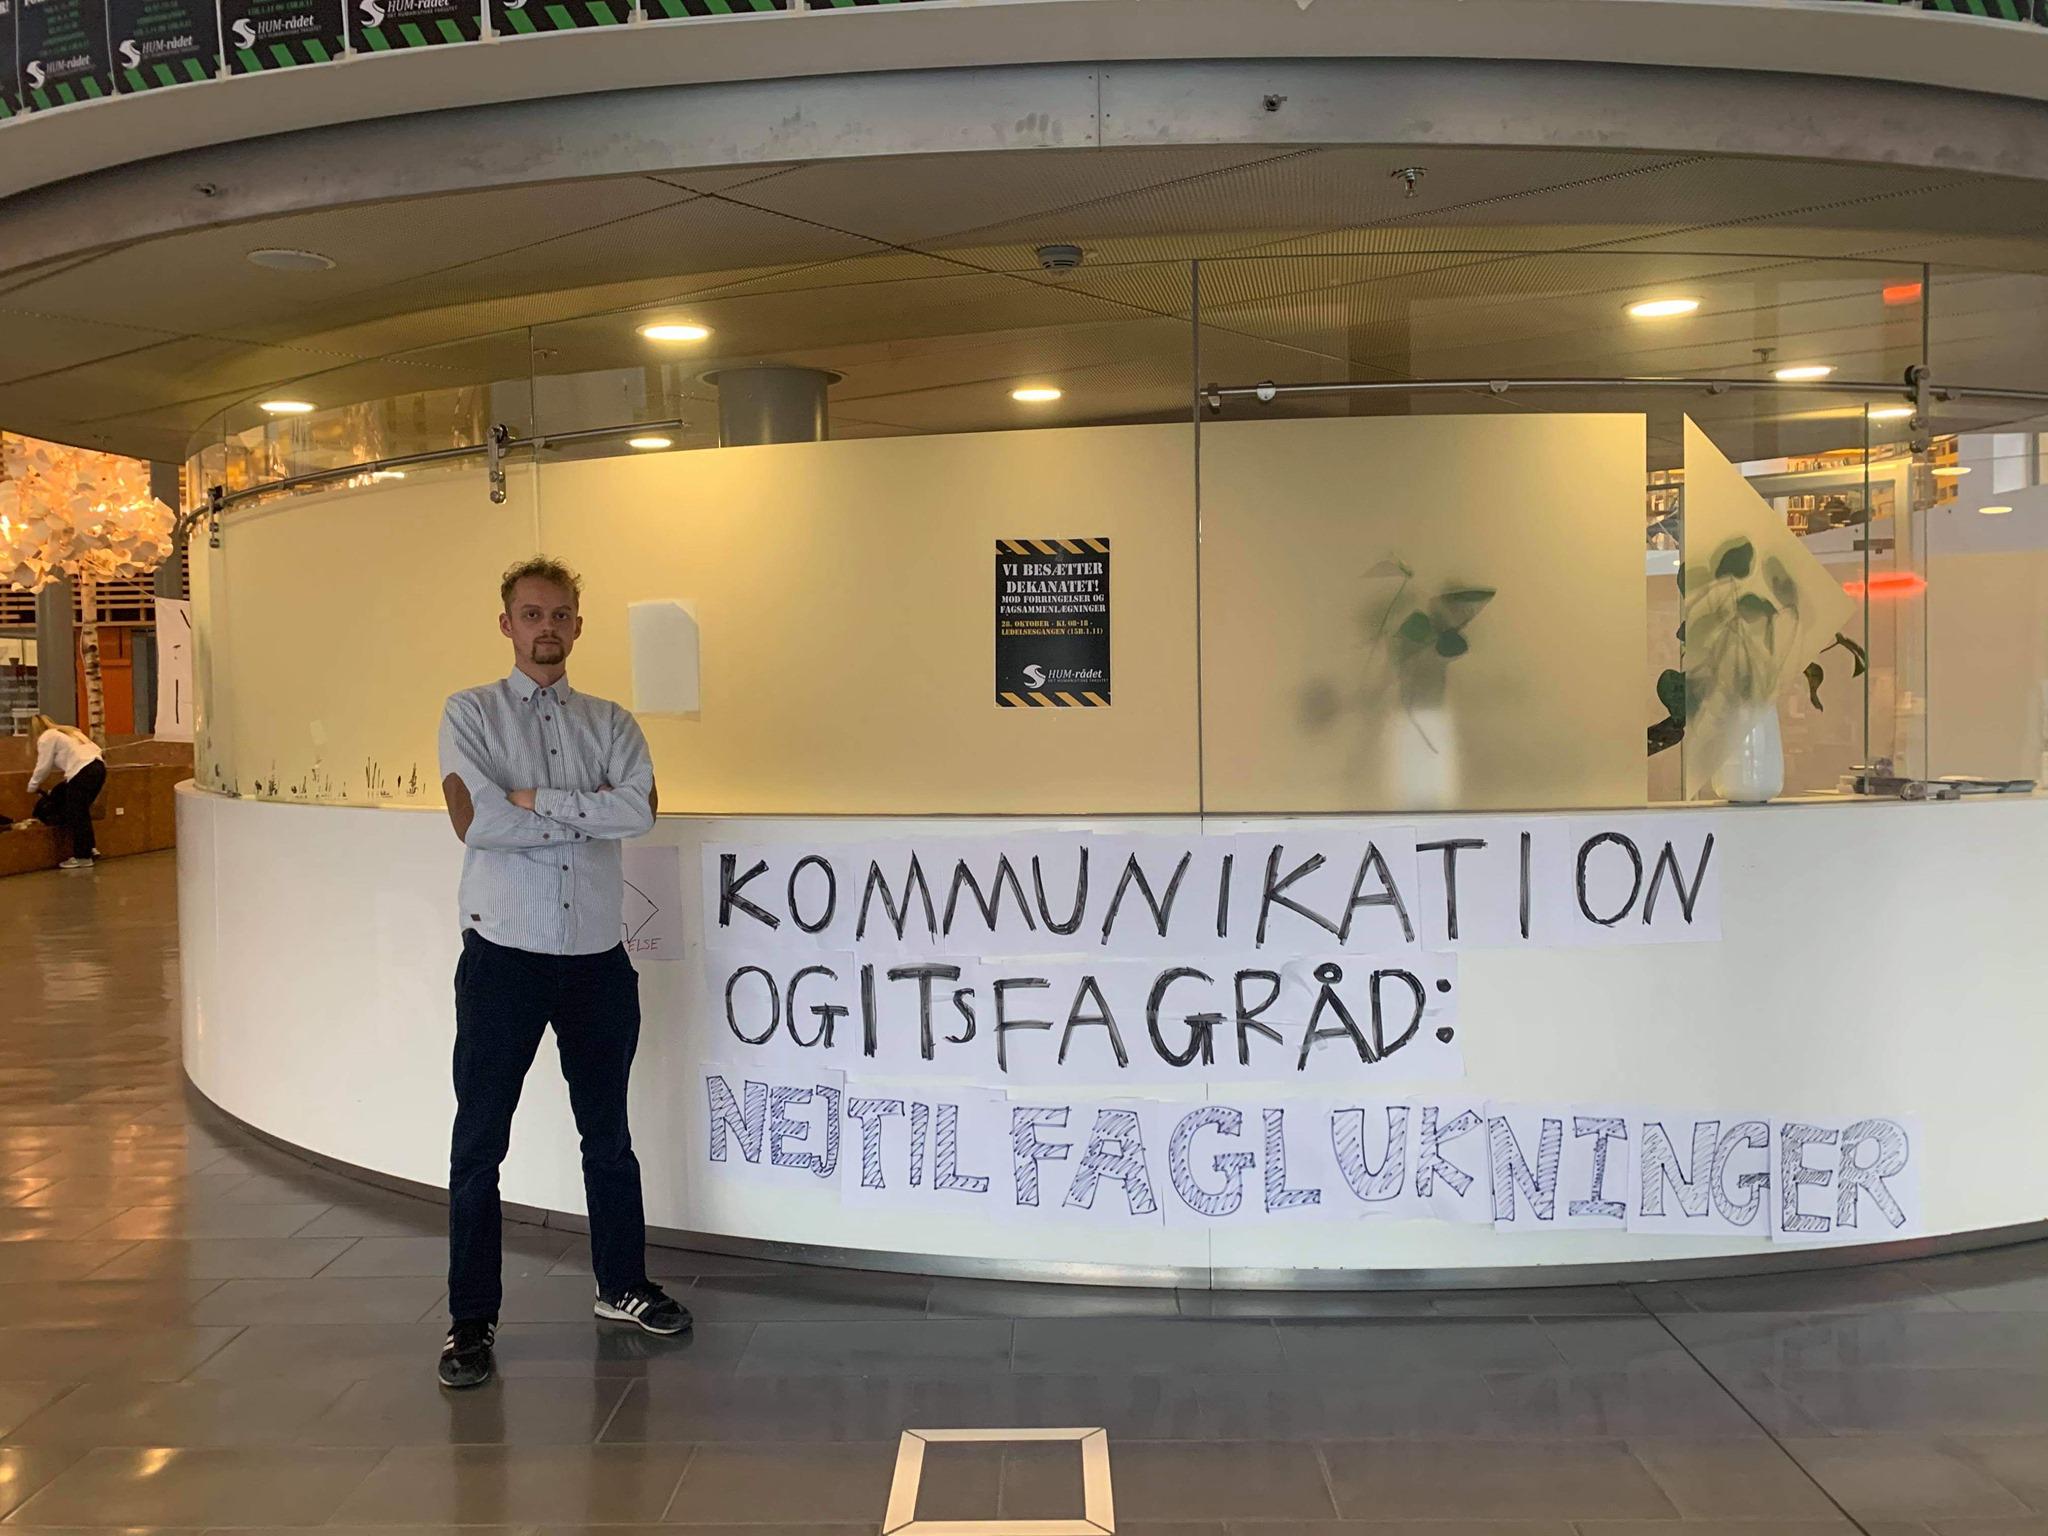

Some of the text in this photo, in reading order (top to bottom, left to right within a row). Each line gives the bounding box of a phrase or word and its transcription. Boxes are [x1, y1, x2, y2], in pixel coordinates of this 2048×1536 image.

[258, 15, 314, 33] HUM-rådet
[1002, 562, 1103, 576] VI BESÆTTER
[1006, 580, 1099, 593] DEKANATET!
[1001, 593, 1105, 603] MOD FORRINGELSER OG
[1000, 604, 1106, 613] FAGSAMMENLÆGNINGER
[1048, 668, 1103, 679] HUM-rådet
[718, 830, 1716, 949] KOMMUNIKATION
[623, 937, 662, 952] ELSE
